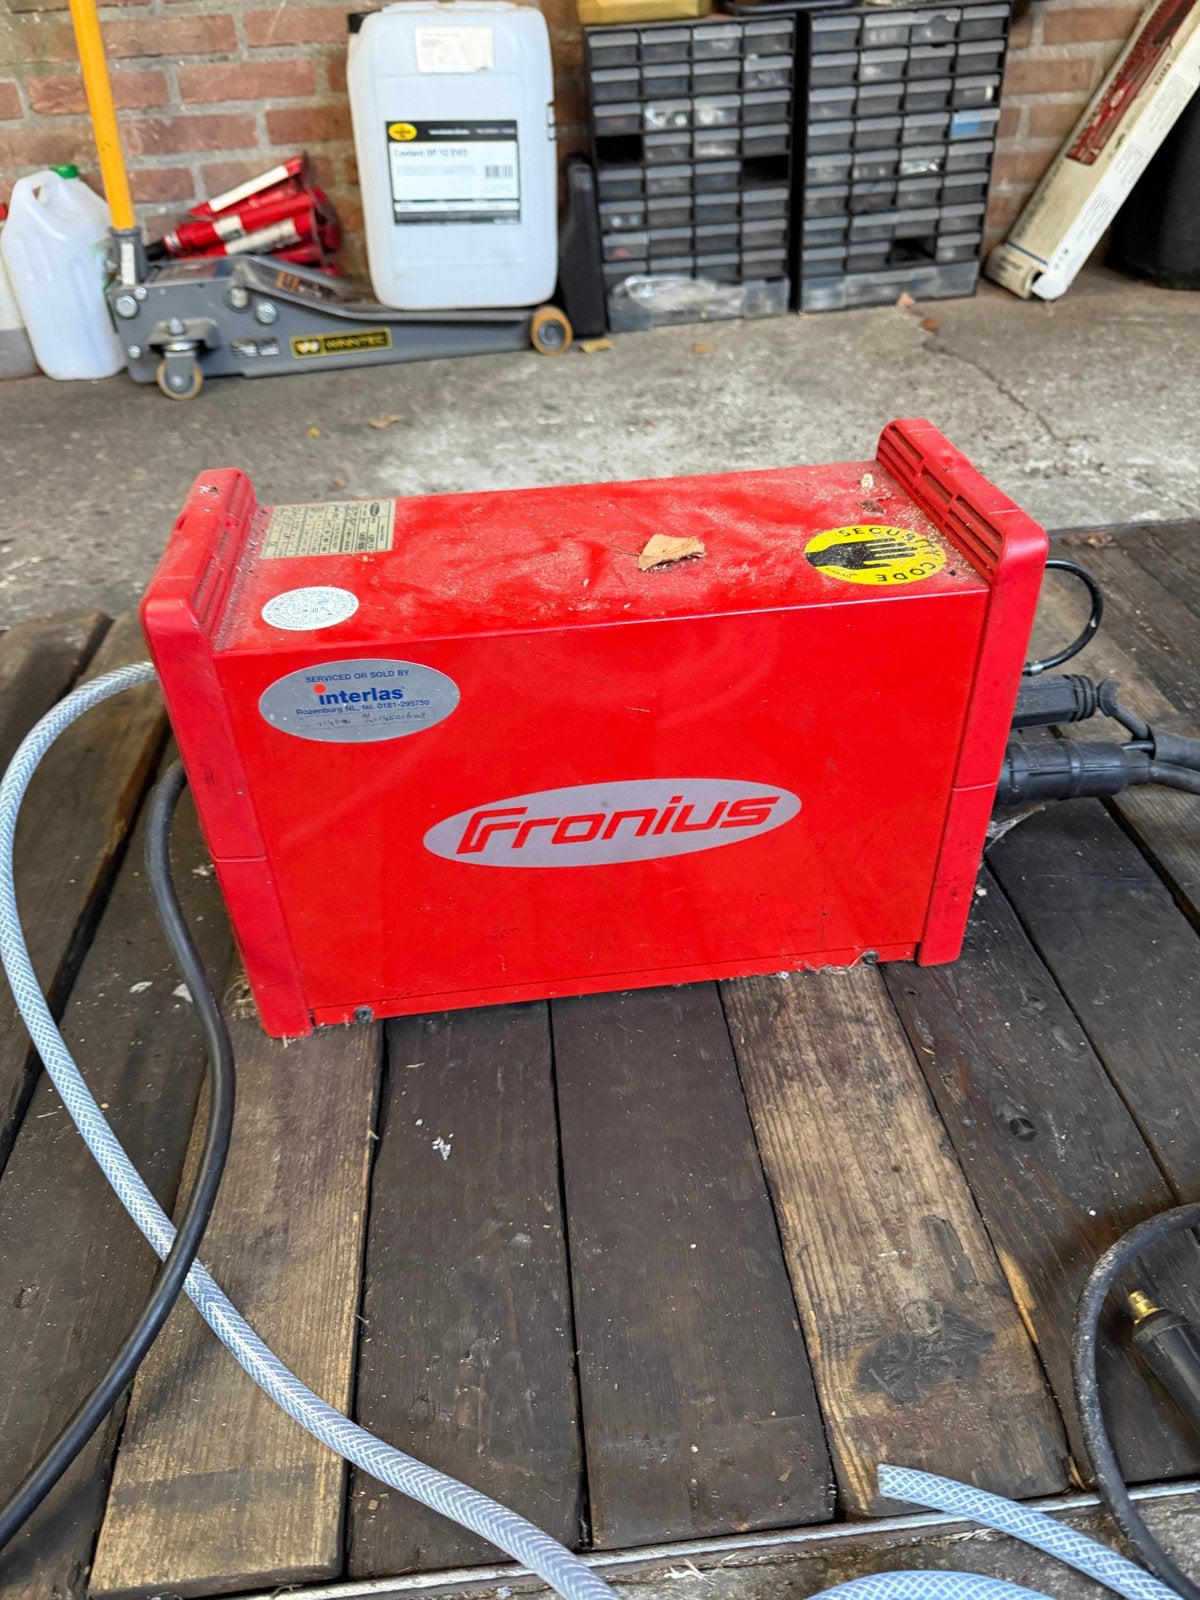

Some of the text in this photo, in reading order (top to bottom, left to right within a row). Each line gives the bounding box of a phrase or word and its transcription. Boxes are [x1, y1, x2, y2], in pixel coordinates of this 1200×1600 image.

[839, 528, 941, 556] SECURITY
[876, 562, 936, 581] CODE
[305, 669, 409, 683] SERVICED OR SOLD BY
[313, 682, 404, 705] interlas
[296, 706, 343, 716] Rozenburg
[377, 699, 430, 709] 0181-295750
[455, 794, 781, 855] Fronius
